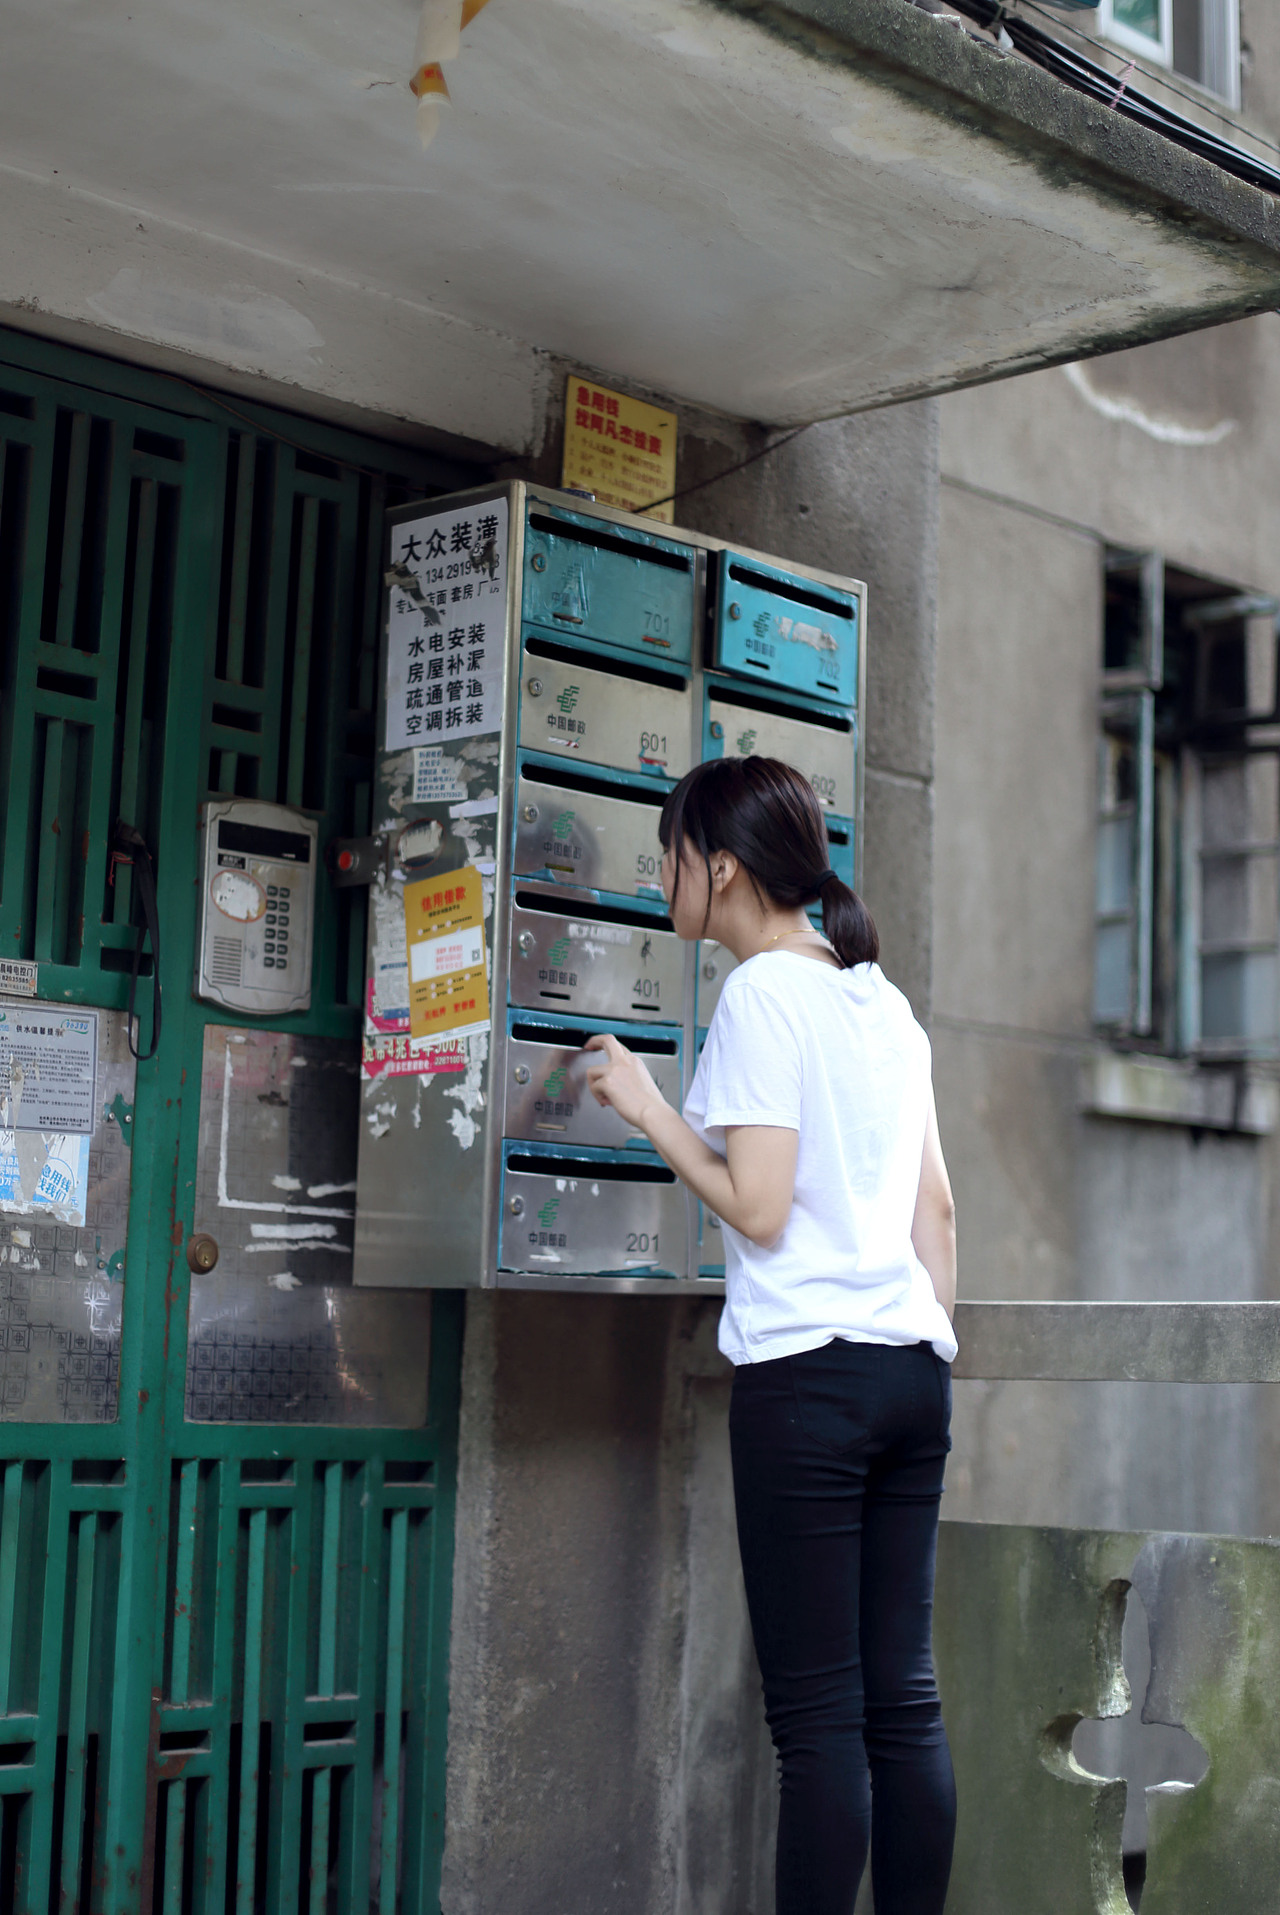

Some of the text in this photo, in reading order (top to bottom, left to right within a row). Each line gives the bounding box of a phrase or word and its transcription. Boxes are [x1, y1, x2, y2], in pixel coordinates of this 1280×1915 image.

[401, 515, 499, 564] 大众装潢
[426, 567, 444, 584] 134
[451, 583, 474, 603] 套房
[644, 610, 670, 634] 701
[407, 622, 486, 658] 水电安装
[407, 648, 485, 684] 房屋补漏
[819, 656, 841, 681] 702
[406, 678, 484, 710] 疏通管道
[406, 701, 484, 736] 空调拆装
[546, 713, 586, 736] 中国邮政
[640, 731, 668, 754] 601
[811, 773, 837, 798] 602
[543, 840, 583, 861] 中国邮政
[637, 853, 663, 876] 501
[538, 969, 578, 988] 中国邮政
[633, 978, 661, 1000] 401
[534, 1100, 574, 1118] 中国邮政
[42, 1164, 70, 1193] 急用钱
[37, 1178, 67, 1203] 找我们
[528, 1231, 568, 1249] 中国邮政
[626, 1233, 660, 1254] 201
